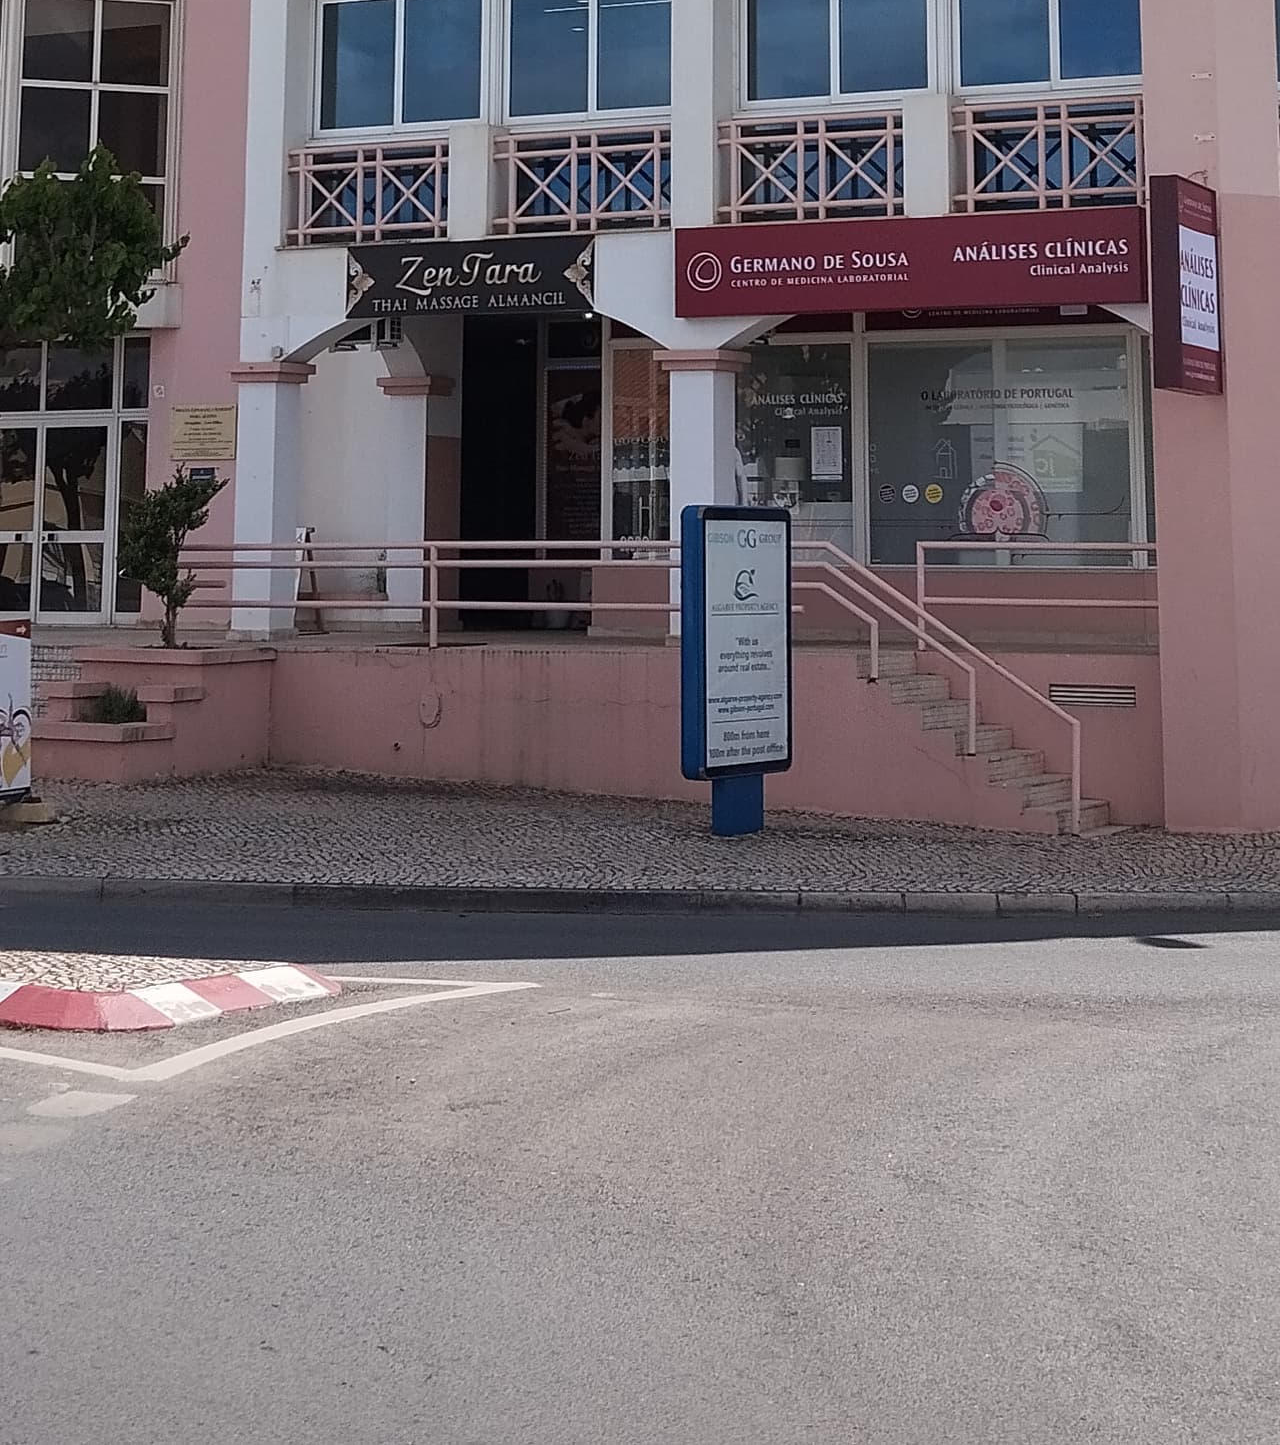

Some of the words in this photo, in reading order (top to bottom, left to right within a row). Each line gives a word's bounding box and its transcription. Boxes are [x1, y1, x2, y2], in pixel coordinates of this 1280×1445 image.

[953, 242, 1038, 262] ANÁLISES
[1045, 238, 1129, 258] CLÍNICAS
[731, 256, 816, 273] GERMANO
[824, 256, 844, 269] DE
[851, 251, 909, 268] SOUSA
[1030, 264, 1075, 276] Clinical
[1079, 261, 1129, 274] Analysis
[1180, 248, 1214, 279] ANÁLISES
[731, 278, 767, 287] CENTRO
[771, 277, 783, 286] DE
[787, 276, 834, 285] MEDICINA
[837, 273, 909, 283] LABORATORIAL
[372, 299, 407, 312] THAI
[416, 296, 479, 311] MASSAGE
[488, 292, 566, 307] ALMANCIL
[1181, 281, 1215, 314] CLÍNICAS
[921, 390, 928, 401] O
[931, 387, 1001, 401] LABORATÓRIO
[1004, 388, 1019, 399] DE
[1020, 387, 1073, 399] PORTUGAL
[720, 651, 749, 662] everything
[718, 665, 738, 673] around
